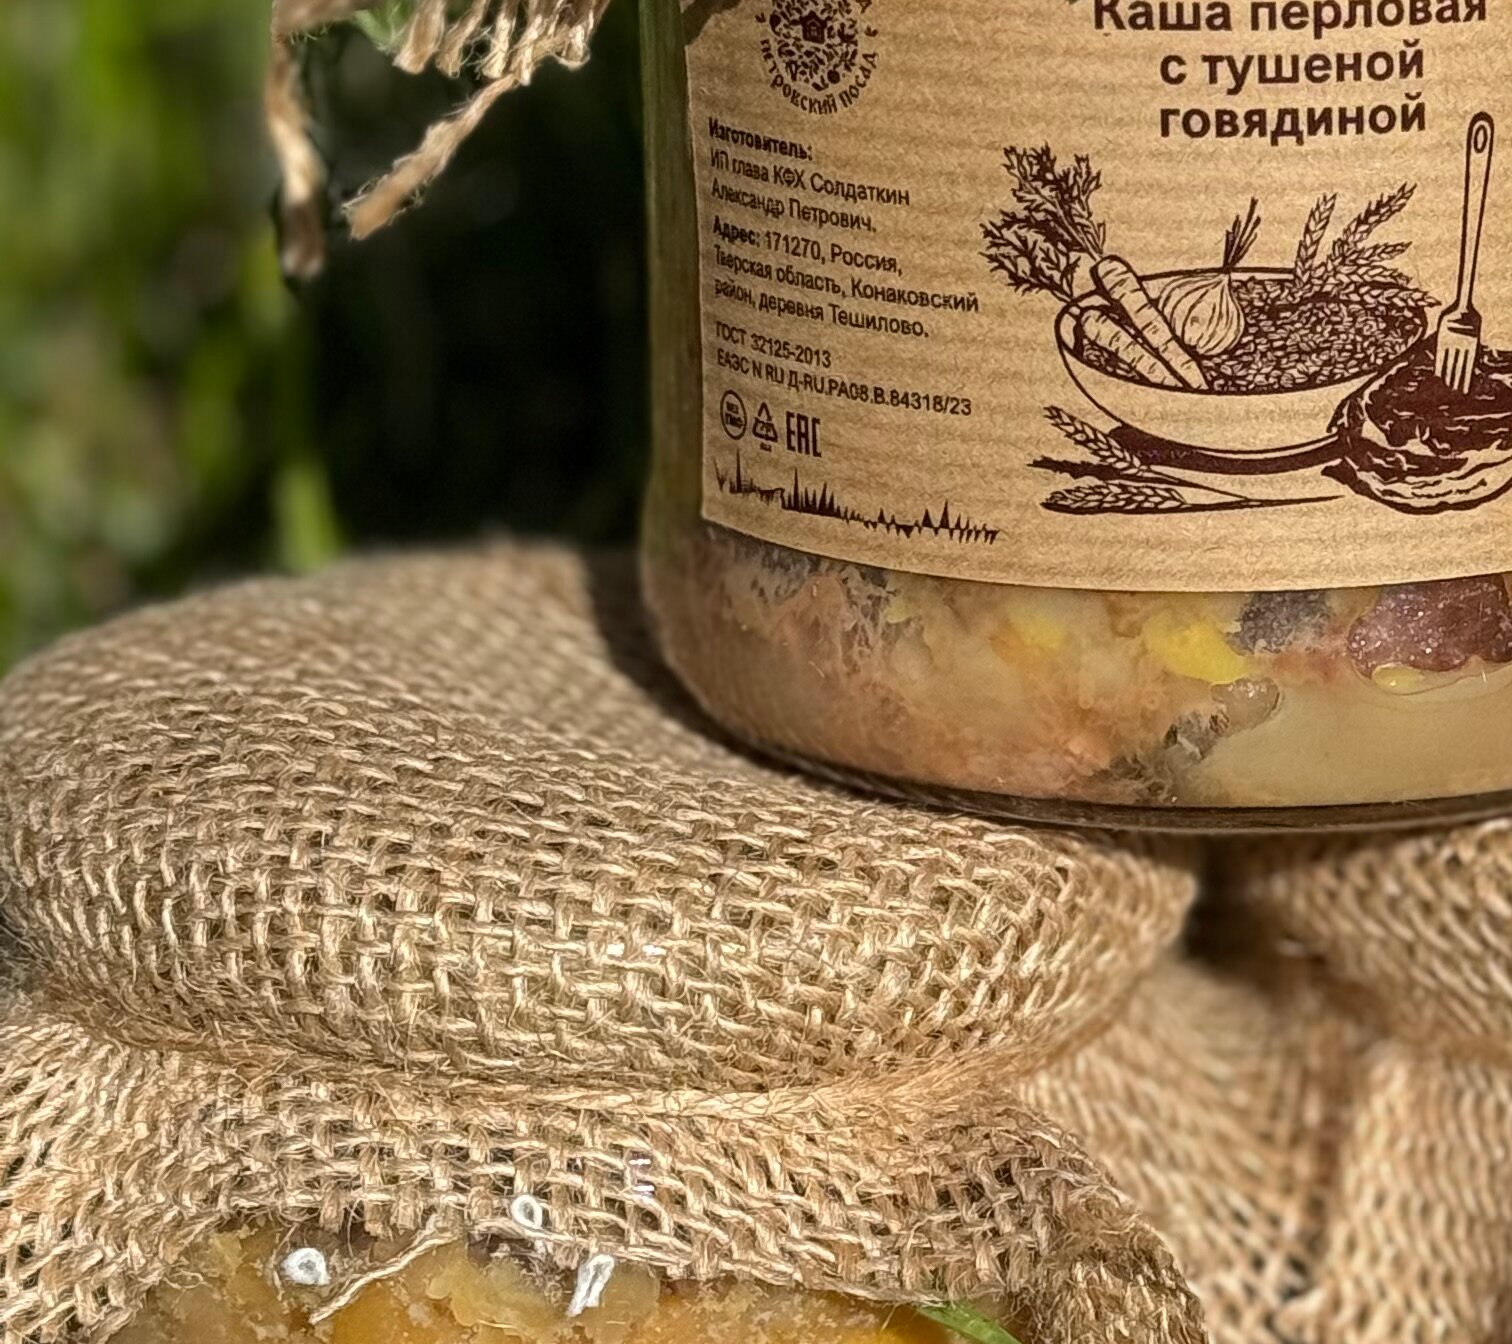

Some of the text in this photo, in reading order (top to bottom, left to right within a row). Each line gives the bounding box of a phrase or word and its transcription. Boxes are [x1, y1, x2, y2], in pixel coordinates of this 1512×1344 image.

[838, 51, 880, 109] ПОСАД
[1159, 38, 1425, 95] с тушеной
[708, 116, 814, 162] Изготовитель:
[1159, 91, 1427, 147] говядиной
[710, 147, 910, 206] ИП глава КФХ Солдаткин
[711, 177, 878, 233] Александр Петрович.
[712, 214, 903, 277] Адрес: 171270, Россия,
[713, 244, 980, 313] Тверская область, Конаковский
[758, 292, 824, 321] деревня
[828, 302, 929, 338] Тешилово.
[715, 320, 832, 369] ГОСТ 32125-2013
[716, 347, 750, 375] ЕАЭС
[765, 363, 785, 385] RU
